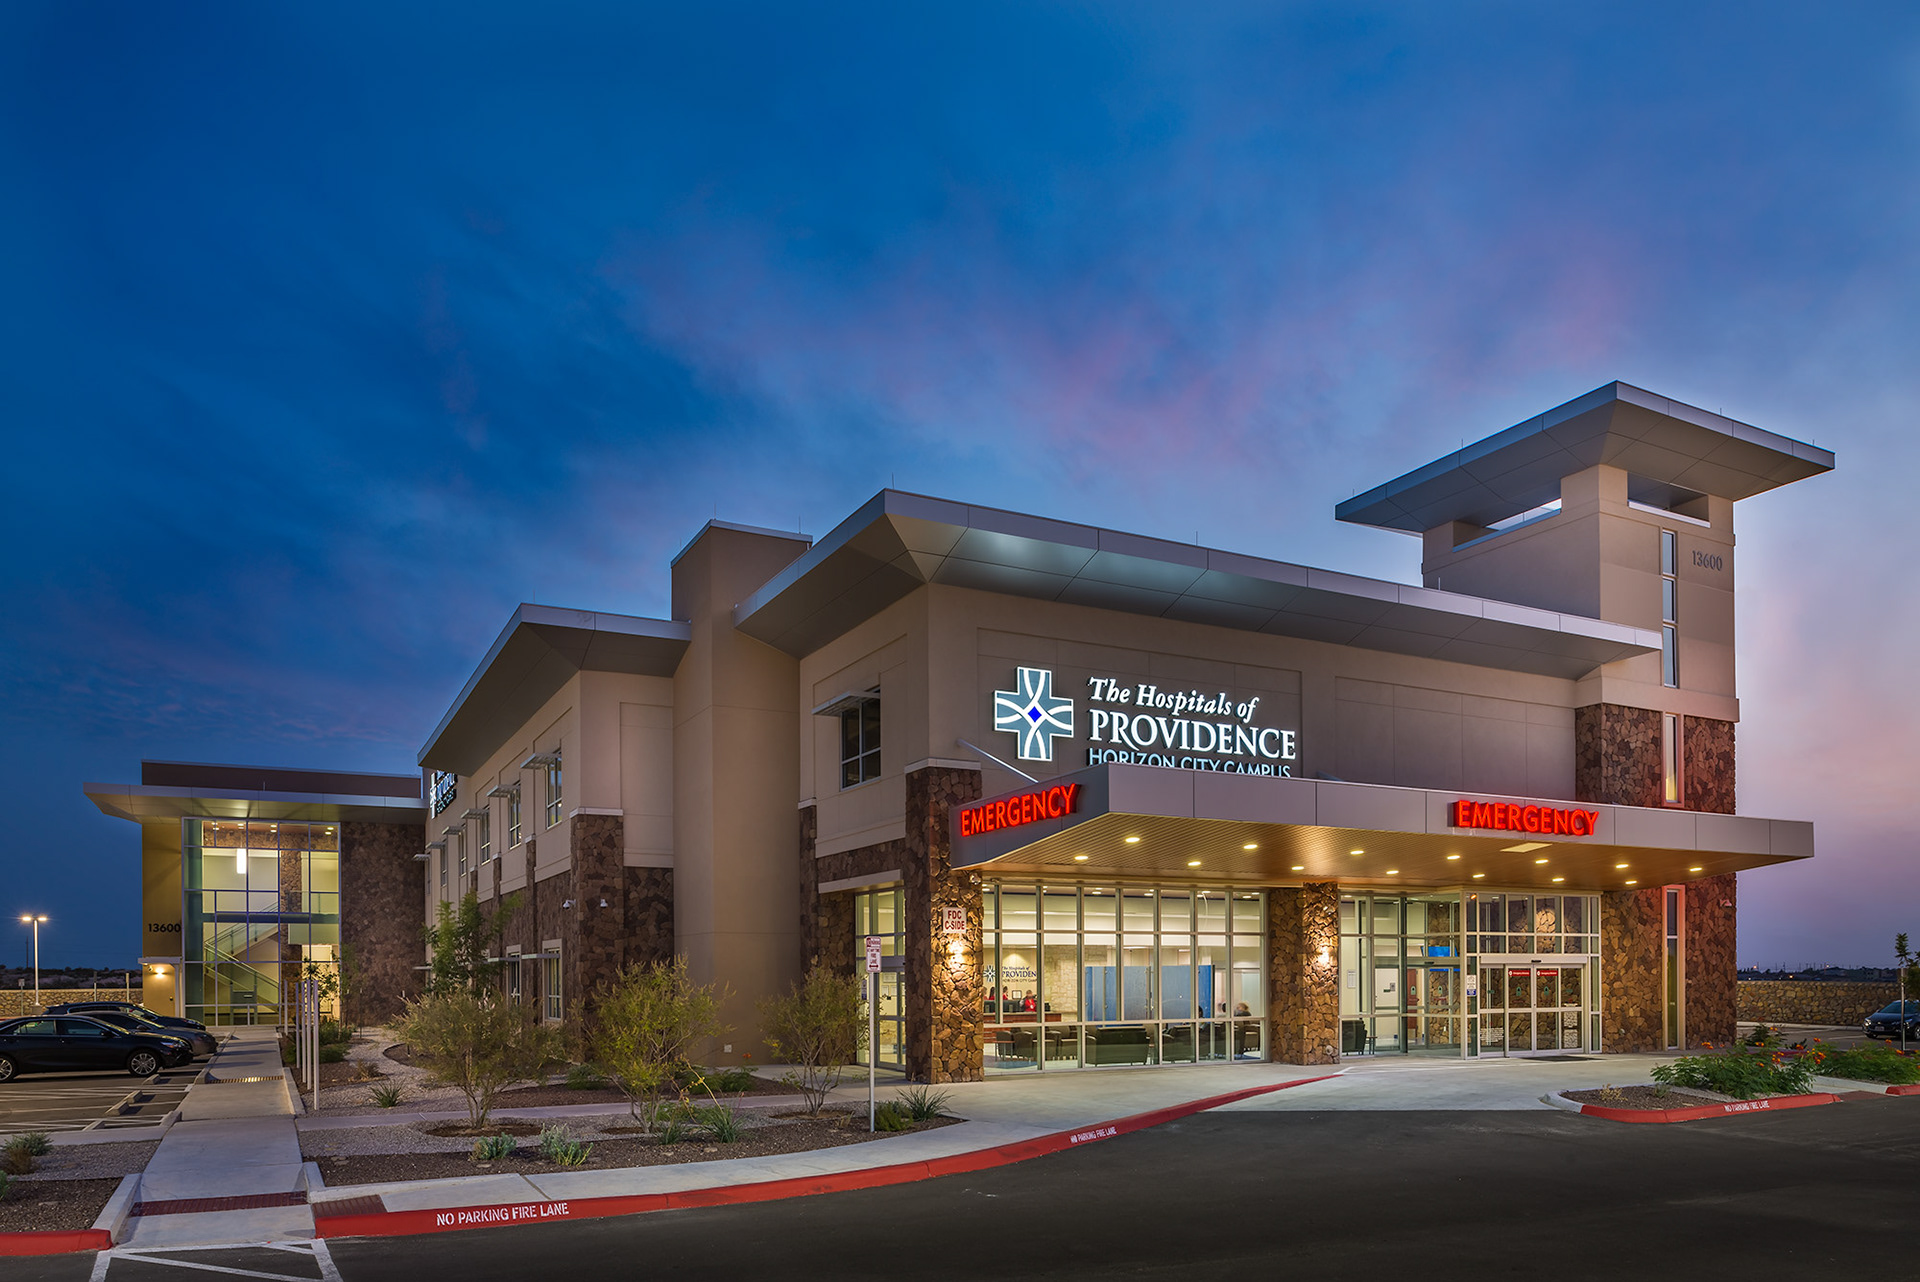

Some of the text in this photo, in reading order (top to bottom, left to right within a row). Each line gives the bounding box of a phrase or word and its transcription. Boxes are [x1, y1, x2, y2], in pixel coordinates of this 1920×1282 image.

[1692, 550, 1722, 571] 13600
[1088, 677, 1260, 724] The Hospitals of
[1089, 708, 1297, 761] PROVIDENCE
[1089, 748, 1291, 779] HORIZON CITY CAMPUS
[961, 783, 1077, 838] EMERGENCY
[1457, 800, 1600, 837] EMERGENCY
[944, 921, 965, 931] C-SIDE
[947, 910, 962, 920] FDC
[148, 923, 182, 933] 13600
[1070, 1126, 1116, 1143] NO PARKING FIRE LANE
[436, 1202, 569, 1226] NO PARKING FIRE LANE
